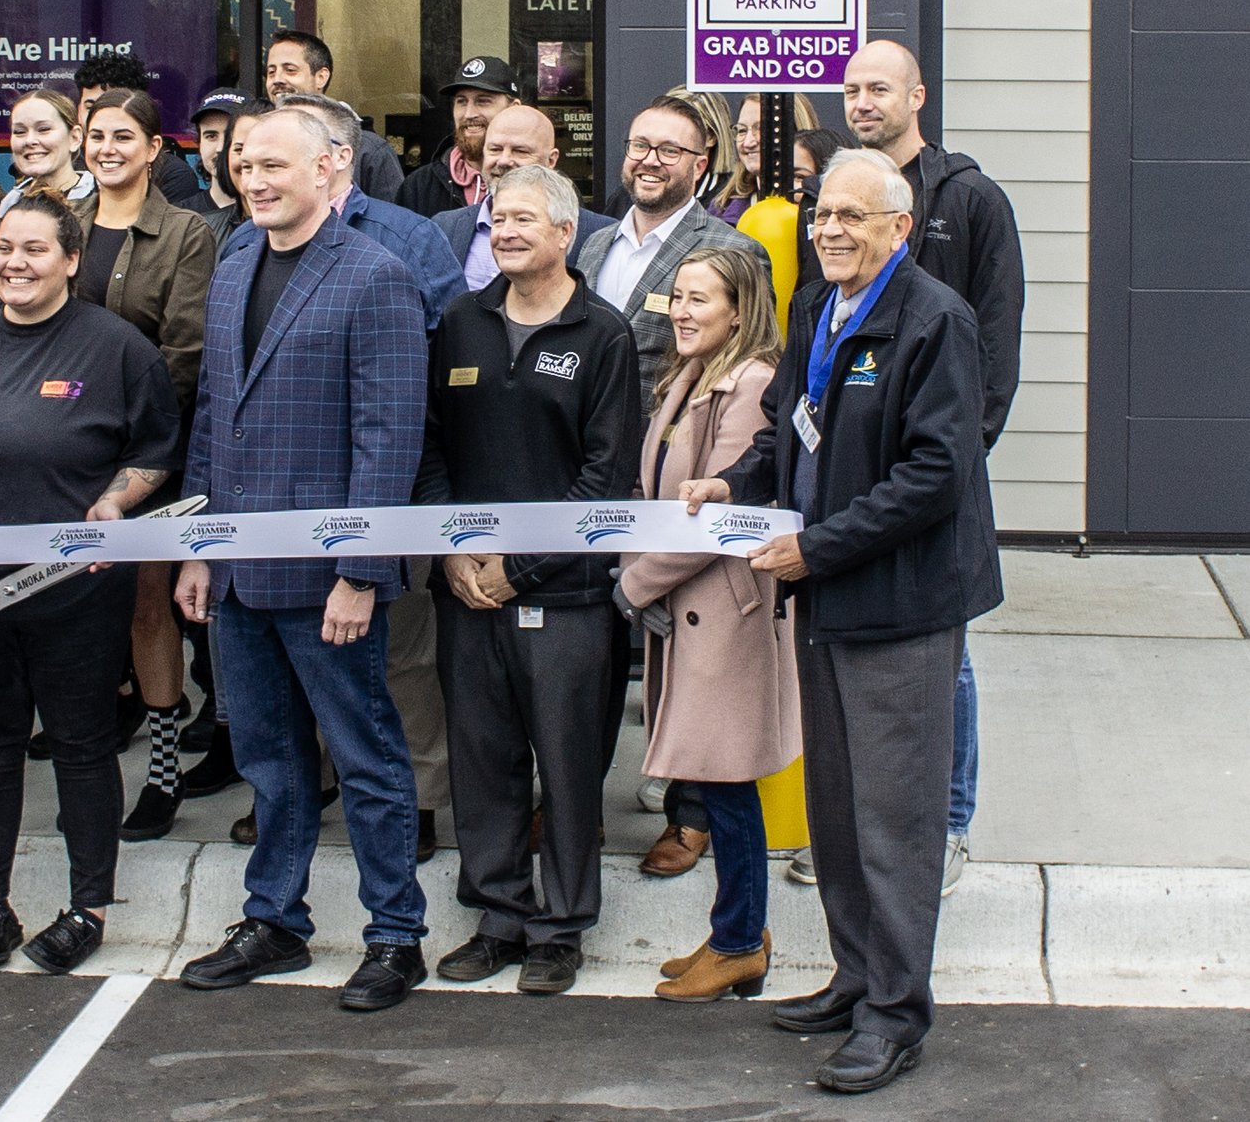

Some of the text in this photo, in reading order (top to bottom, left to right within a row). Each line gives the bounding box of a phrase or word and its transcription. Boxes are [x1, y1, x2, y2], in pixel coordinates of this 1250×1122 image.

[703, 36, 850, 56] GRAB INSIDE
[728, 59, 825, 78] AND GO
[6, 71, 22, 79] with
[33, 71, 47, 79] and
[569, 123, 593, 131] PICKU
[539, 362, 573, 376] RAMSEY
[453, 517, 500, 526] CHAMBER
[589, 514, 636, 523] CHAMBER
[325, 521, 370, 530] CHAMBER
[724, 519, 770, 531] CHAMBER
[191, 526, 238, 535] CHAMBER
[16, 562, 69, 592] ANOKA AREA
